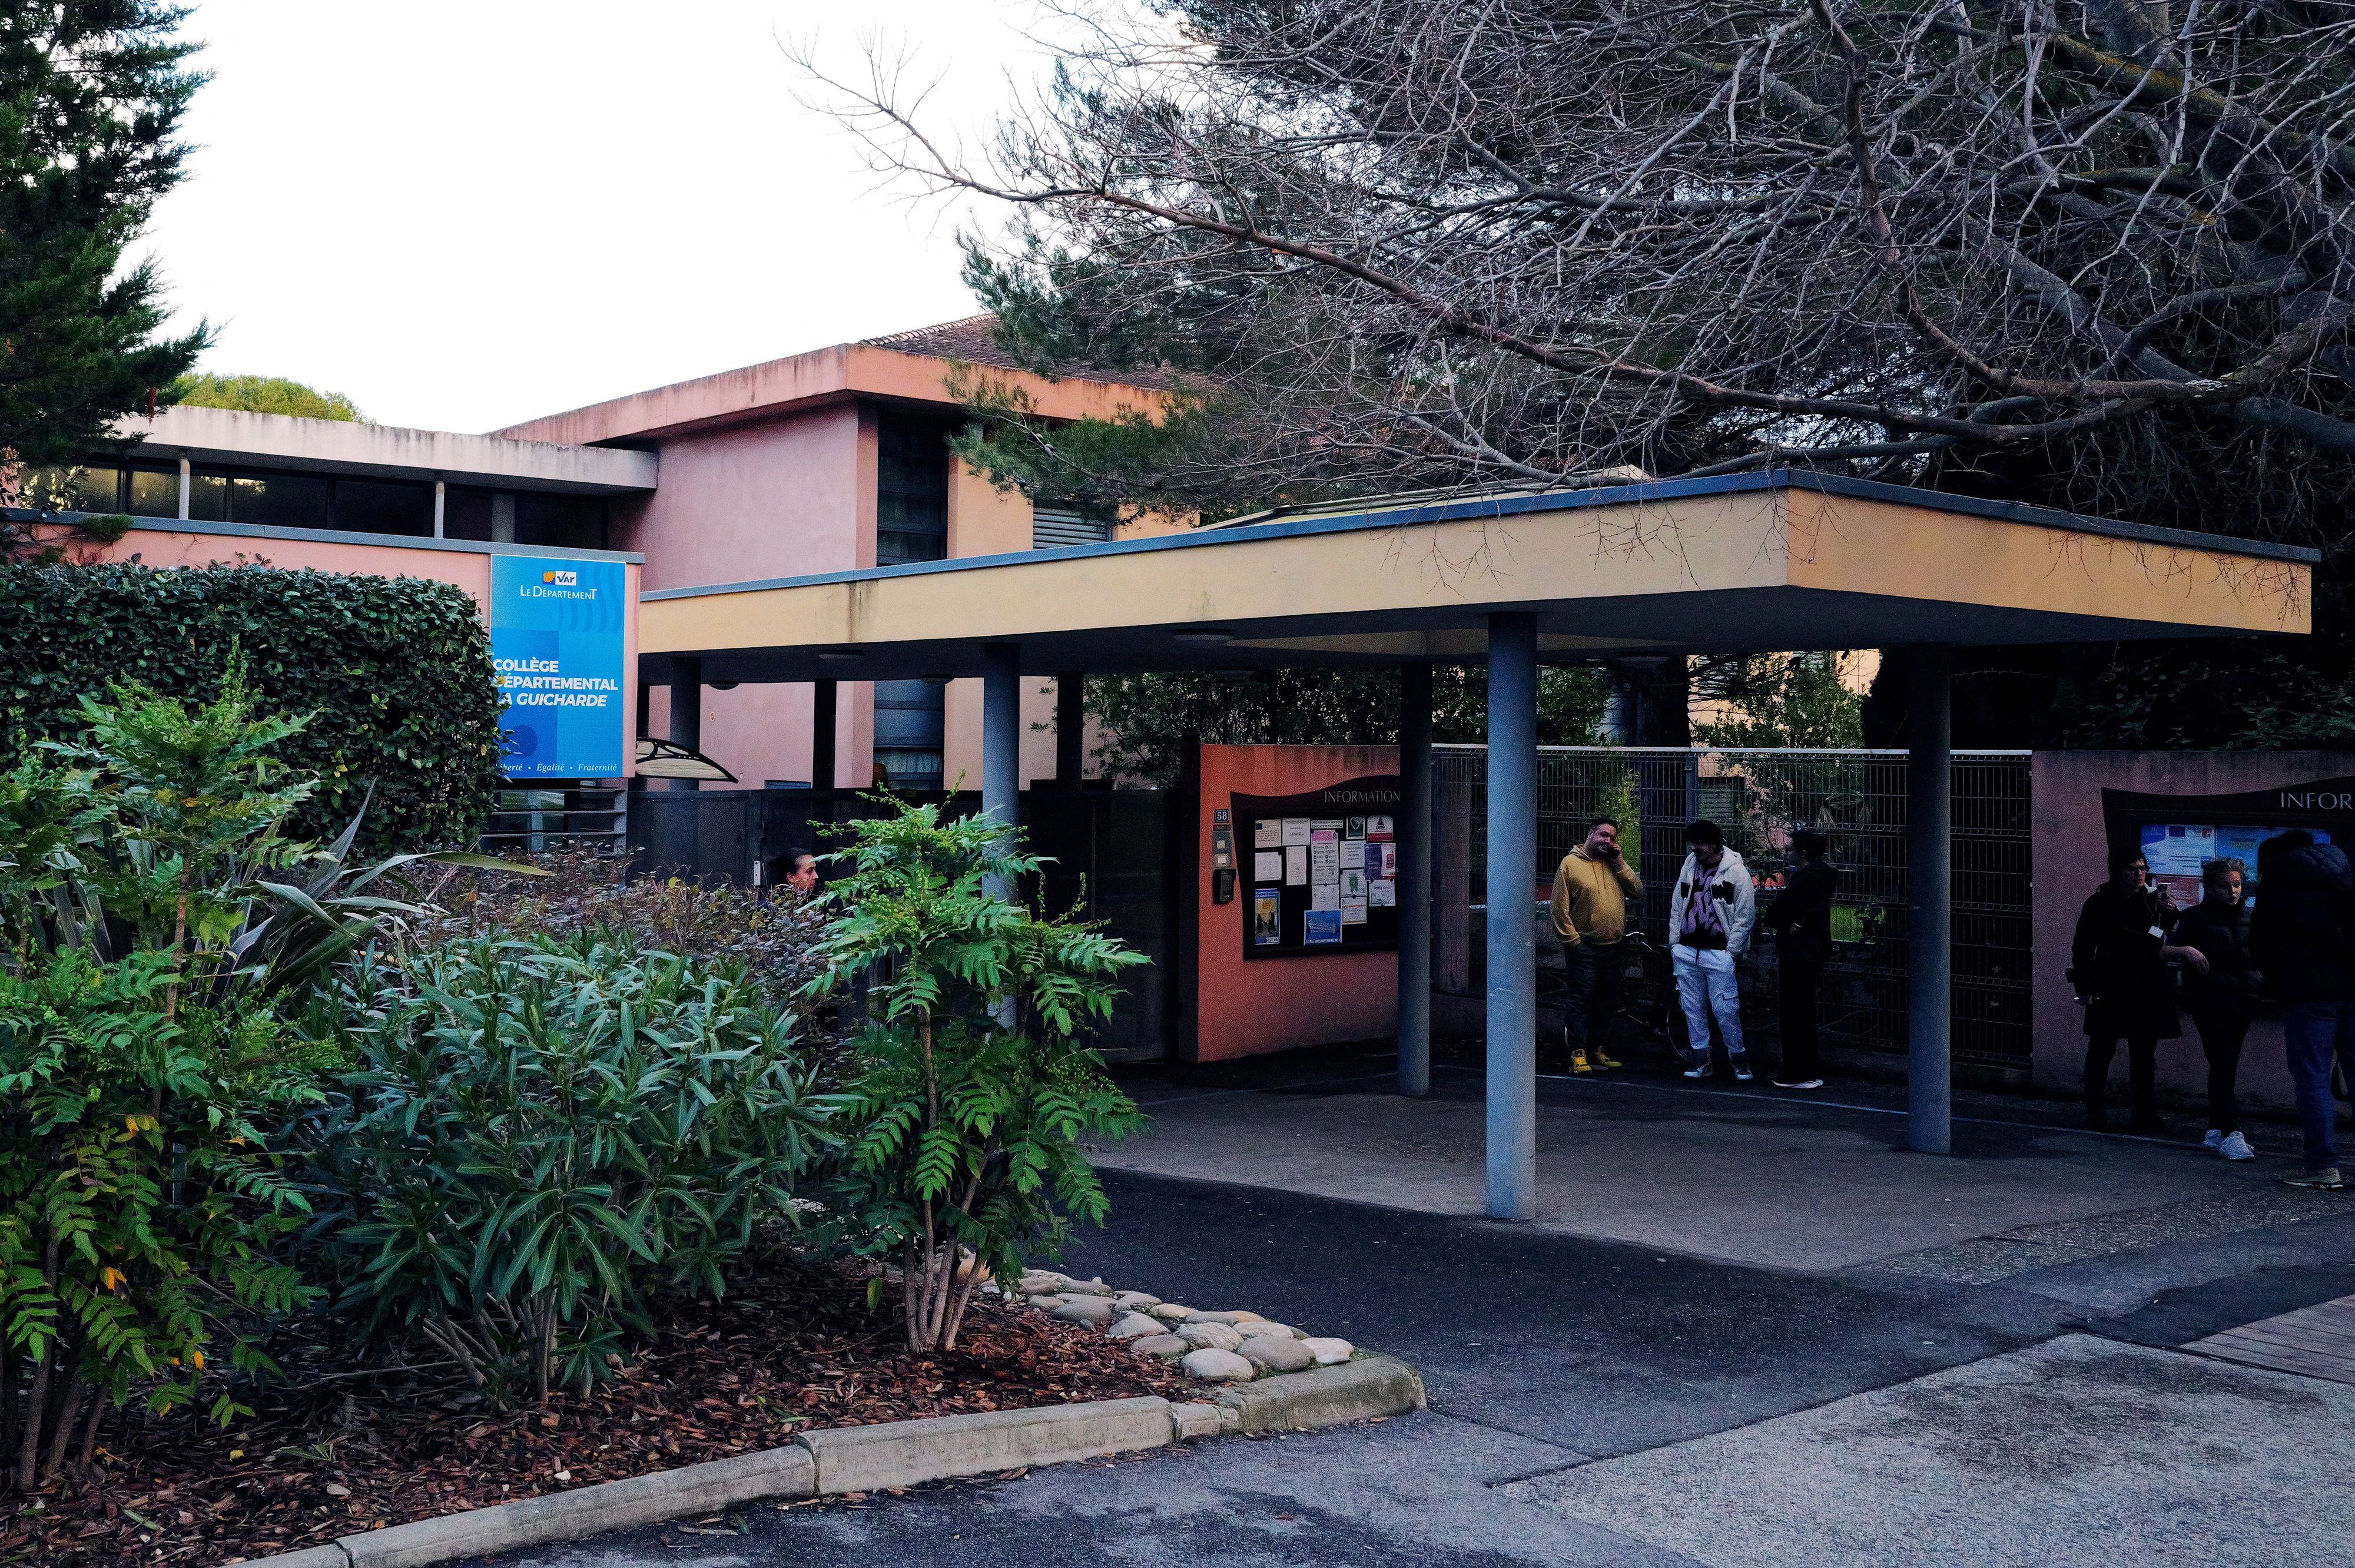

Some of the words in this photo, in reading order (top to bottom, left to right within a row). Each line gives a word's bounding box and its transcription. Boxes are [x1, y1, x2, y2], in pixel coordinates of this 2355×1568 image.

[493, 657, 559, 672] COLLÈGE
[516, 692, 608, 707] GUICHARDE
[536, 762, 565, 773] Égalité
[578, 763, 617, 771] Fraternité
[1325, 790, 1401, 803] INFORMATION
[2281, 791, 2353, 810] INFOR
[1217, 811, 1227, 821] 58
